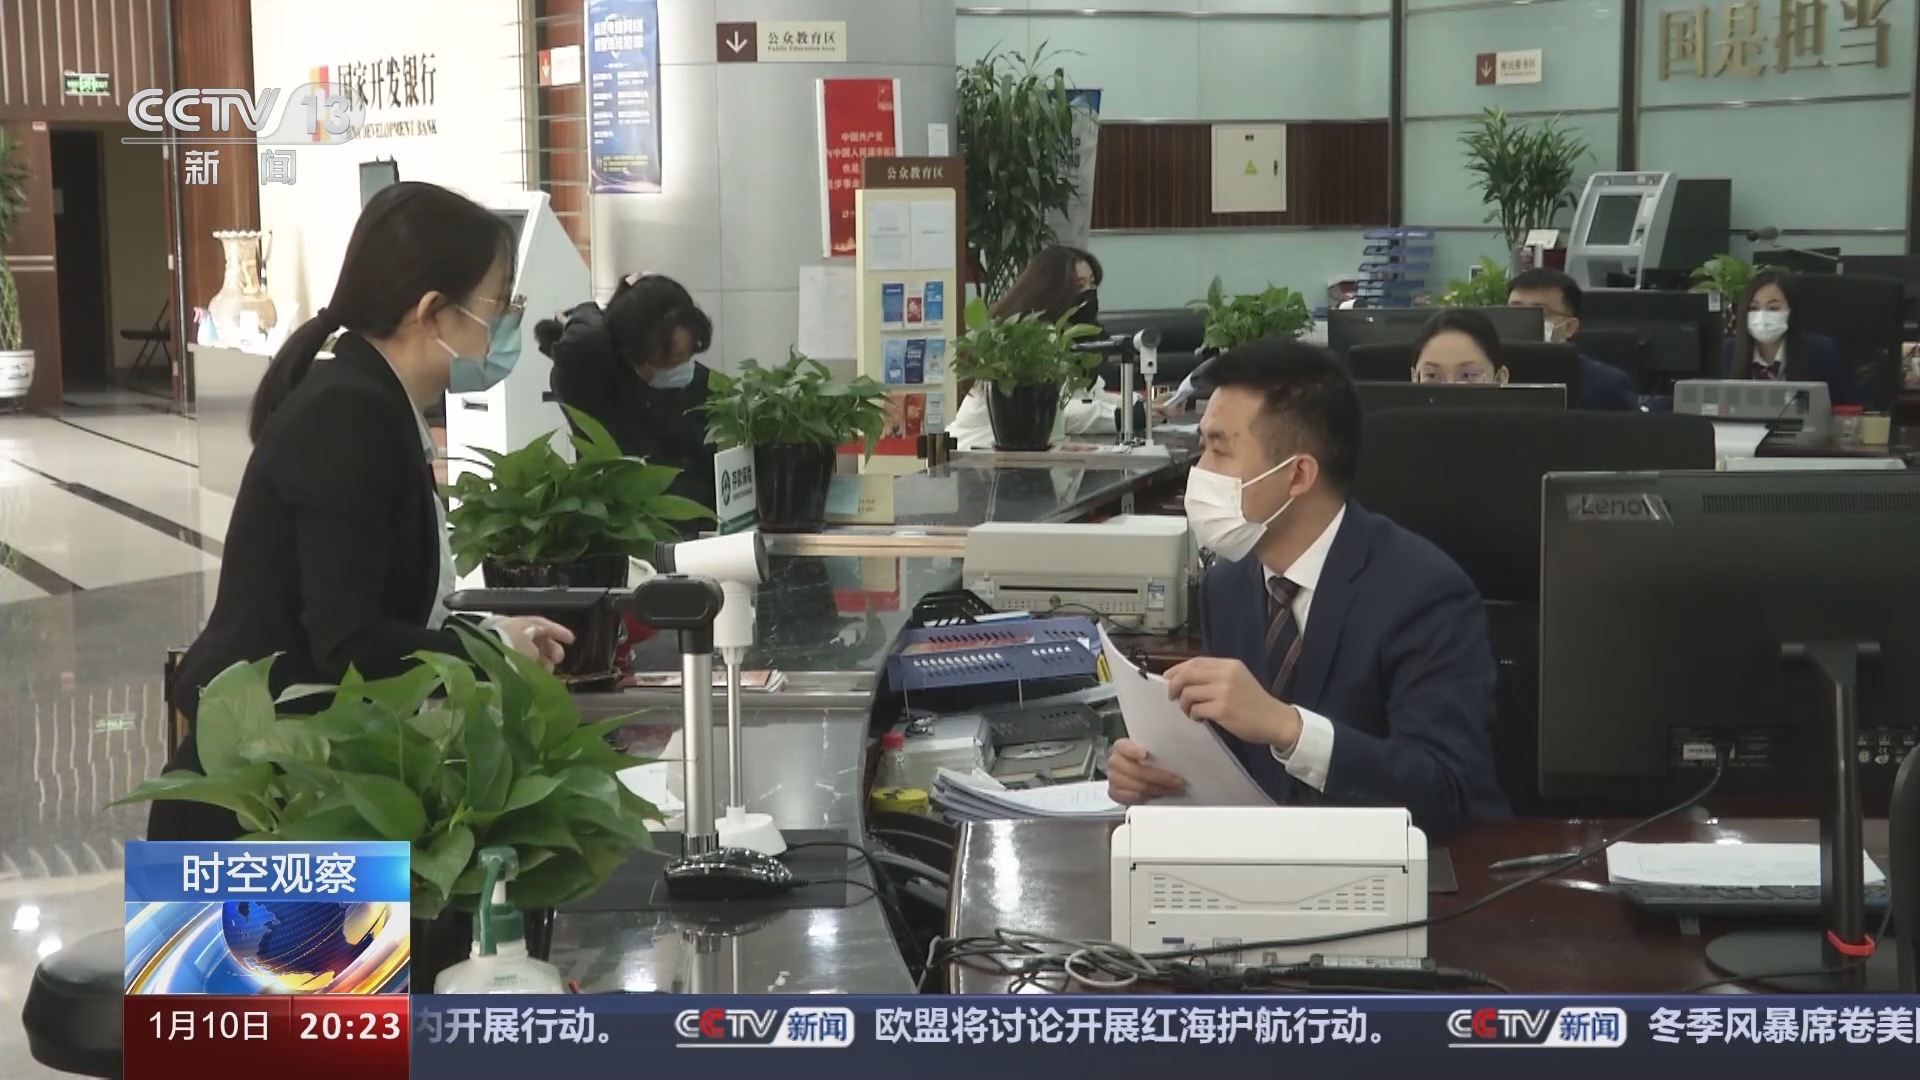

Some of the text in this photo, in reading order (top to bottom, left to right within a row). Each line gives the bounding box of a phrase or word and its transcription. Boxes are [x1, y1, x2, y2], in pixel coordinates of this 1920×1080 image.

[768, 31, 836, 45] 公众教育区
[338, 53, 437, 112] 国家开发银行
[417, 119, 438, 136] BANK
[841, 131, 884, 143] 中国共产党
[887, 166, 944, 181] 公众教育区
